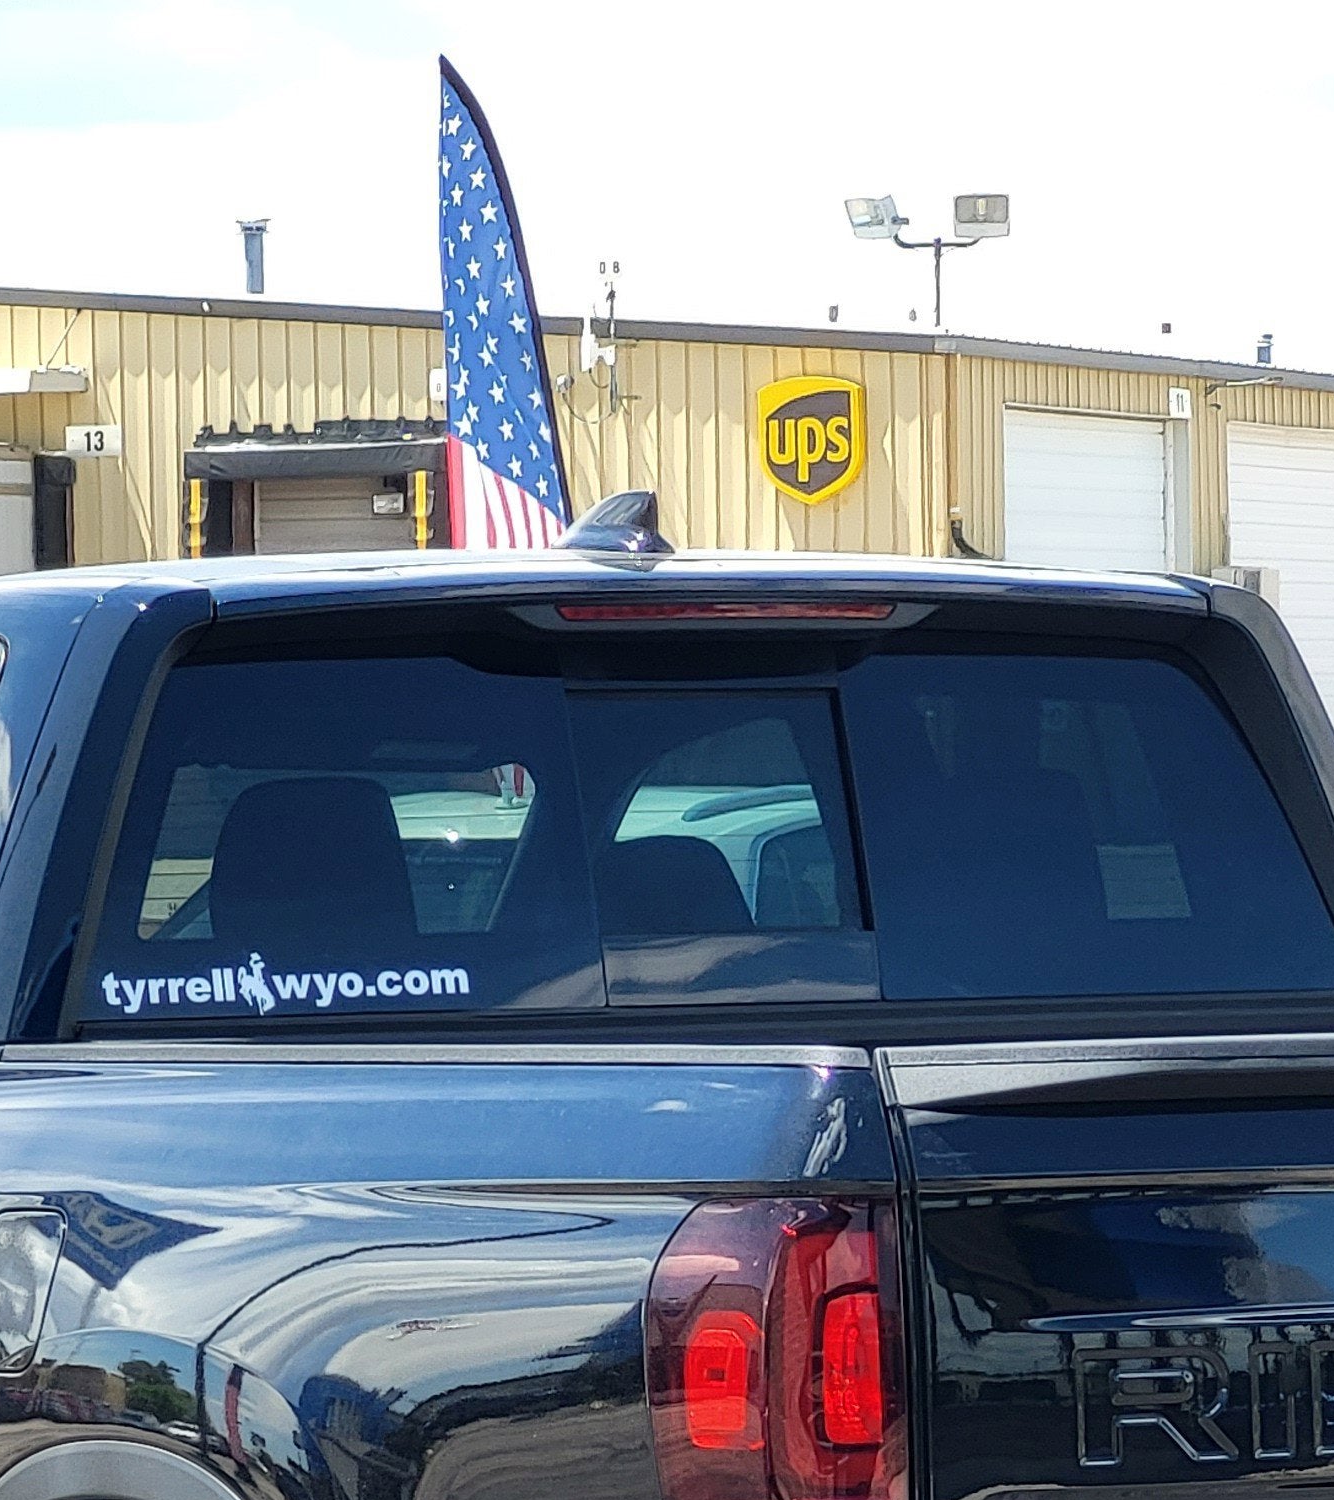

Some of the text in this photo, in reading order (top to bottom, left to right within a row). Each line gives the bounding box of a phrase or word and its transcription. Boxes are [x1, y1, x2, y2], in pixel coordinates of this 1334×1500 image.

[84, 430, 104, 452] 13
[768, 416, 850, 482] ups
[101, 967, 470, 1014] tyrrell wyo.com
